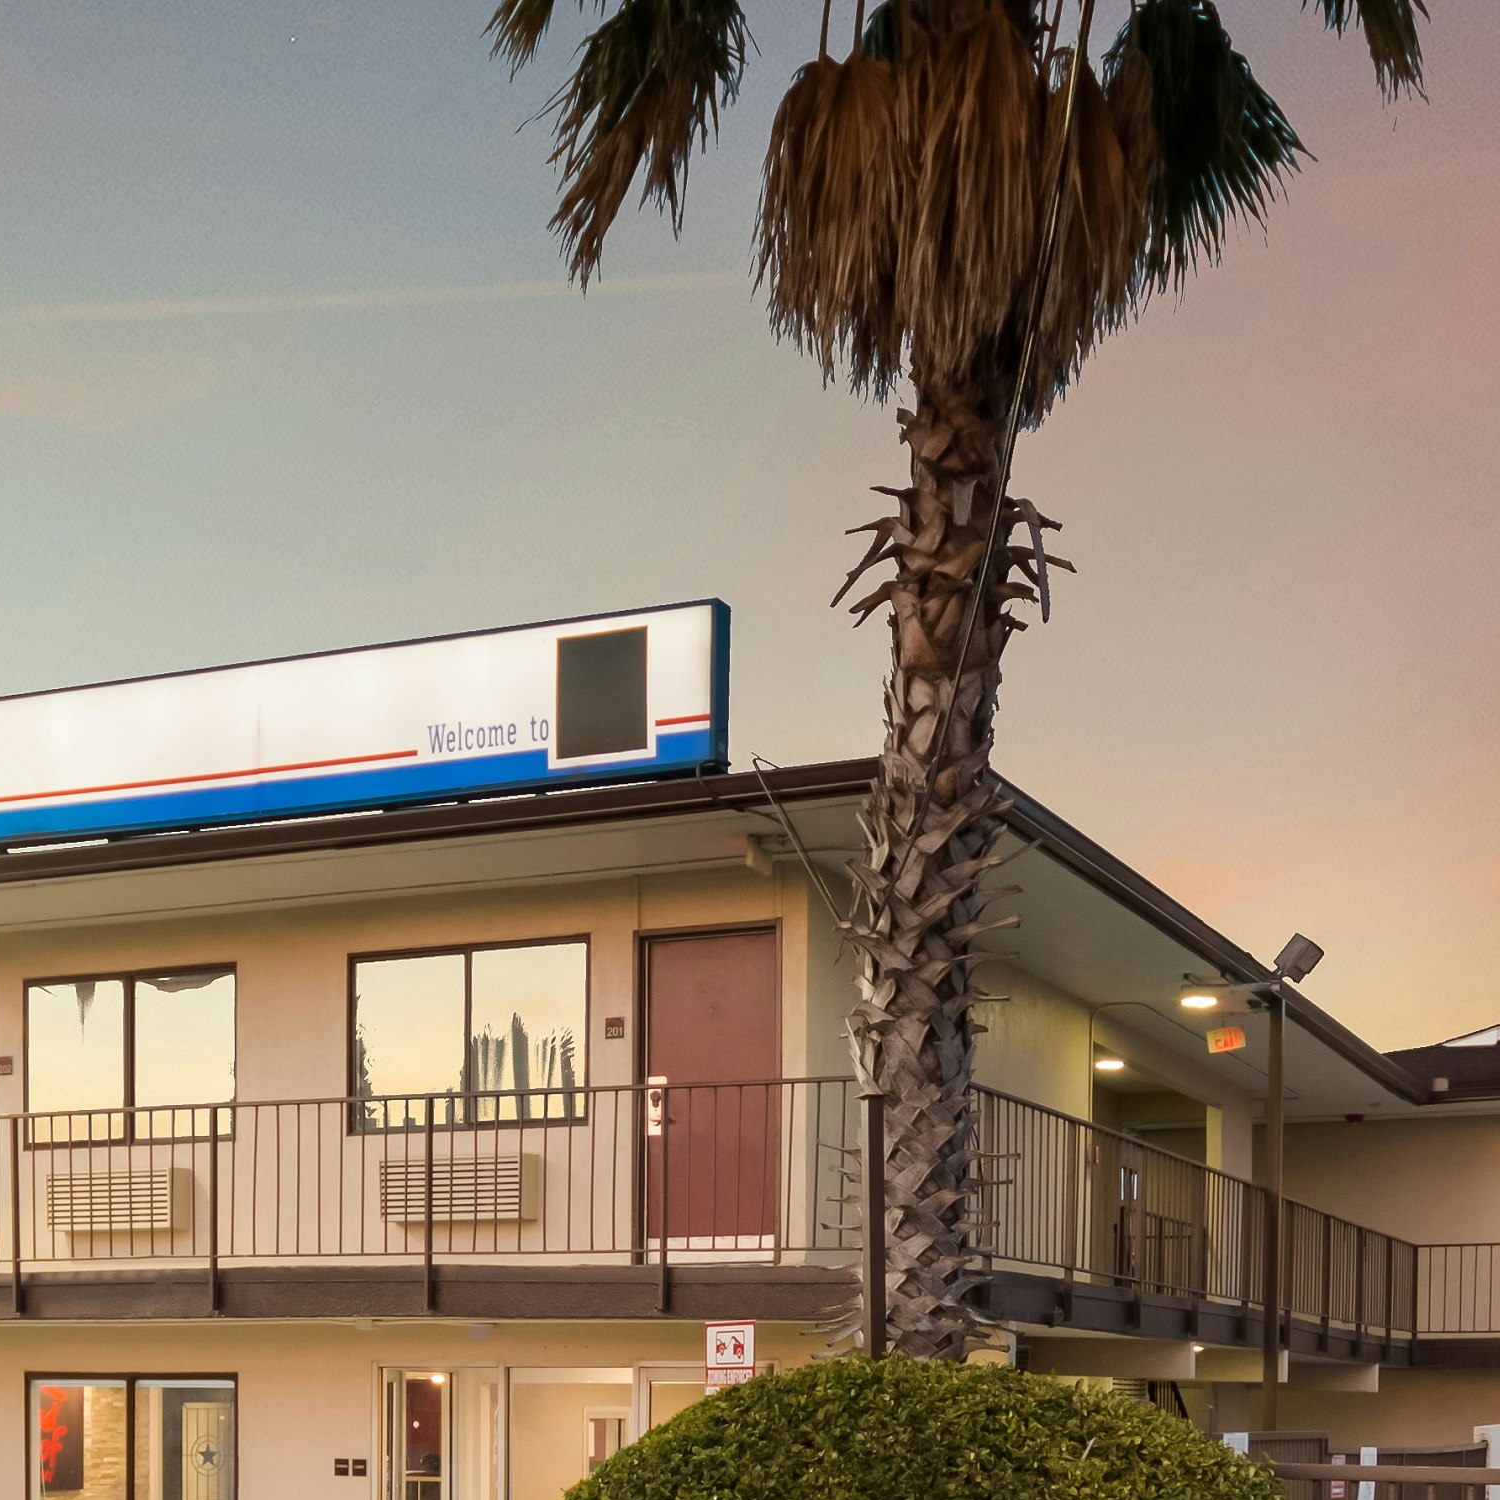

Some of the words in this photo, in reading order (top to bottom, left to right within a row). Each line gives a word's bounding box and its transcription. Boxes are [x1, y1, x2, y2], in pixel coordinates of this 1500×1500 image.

[426, 721, 517, 755] Welcome
[529, 715, 550, 742] to
[606, 1026, 623, 1037] 201
